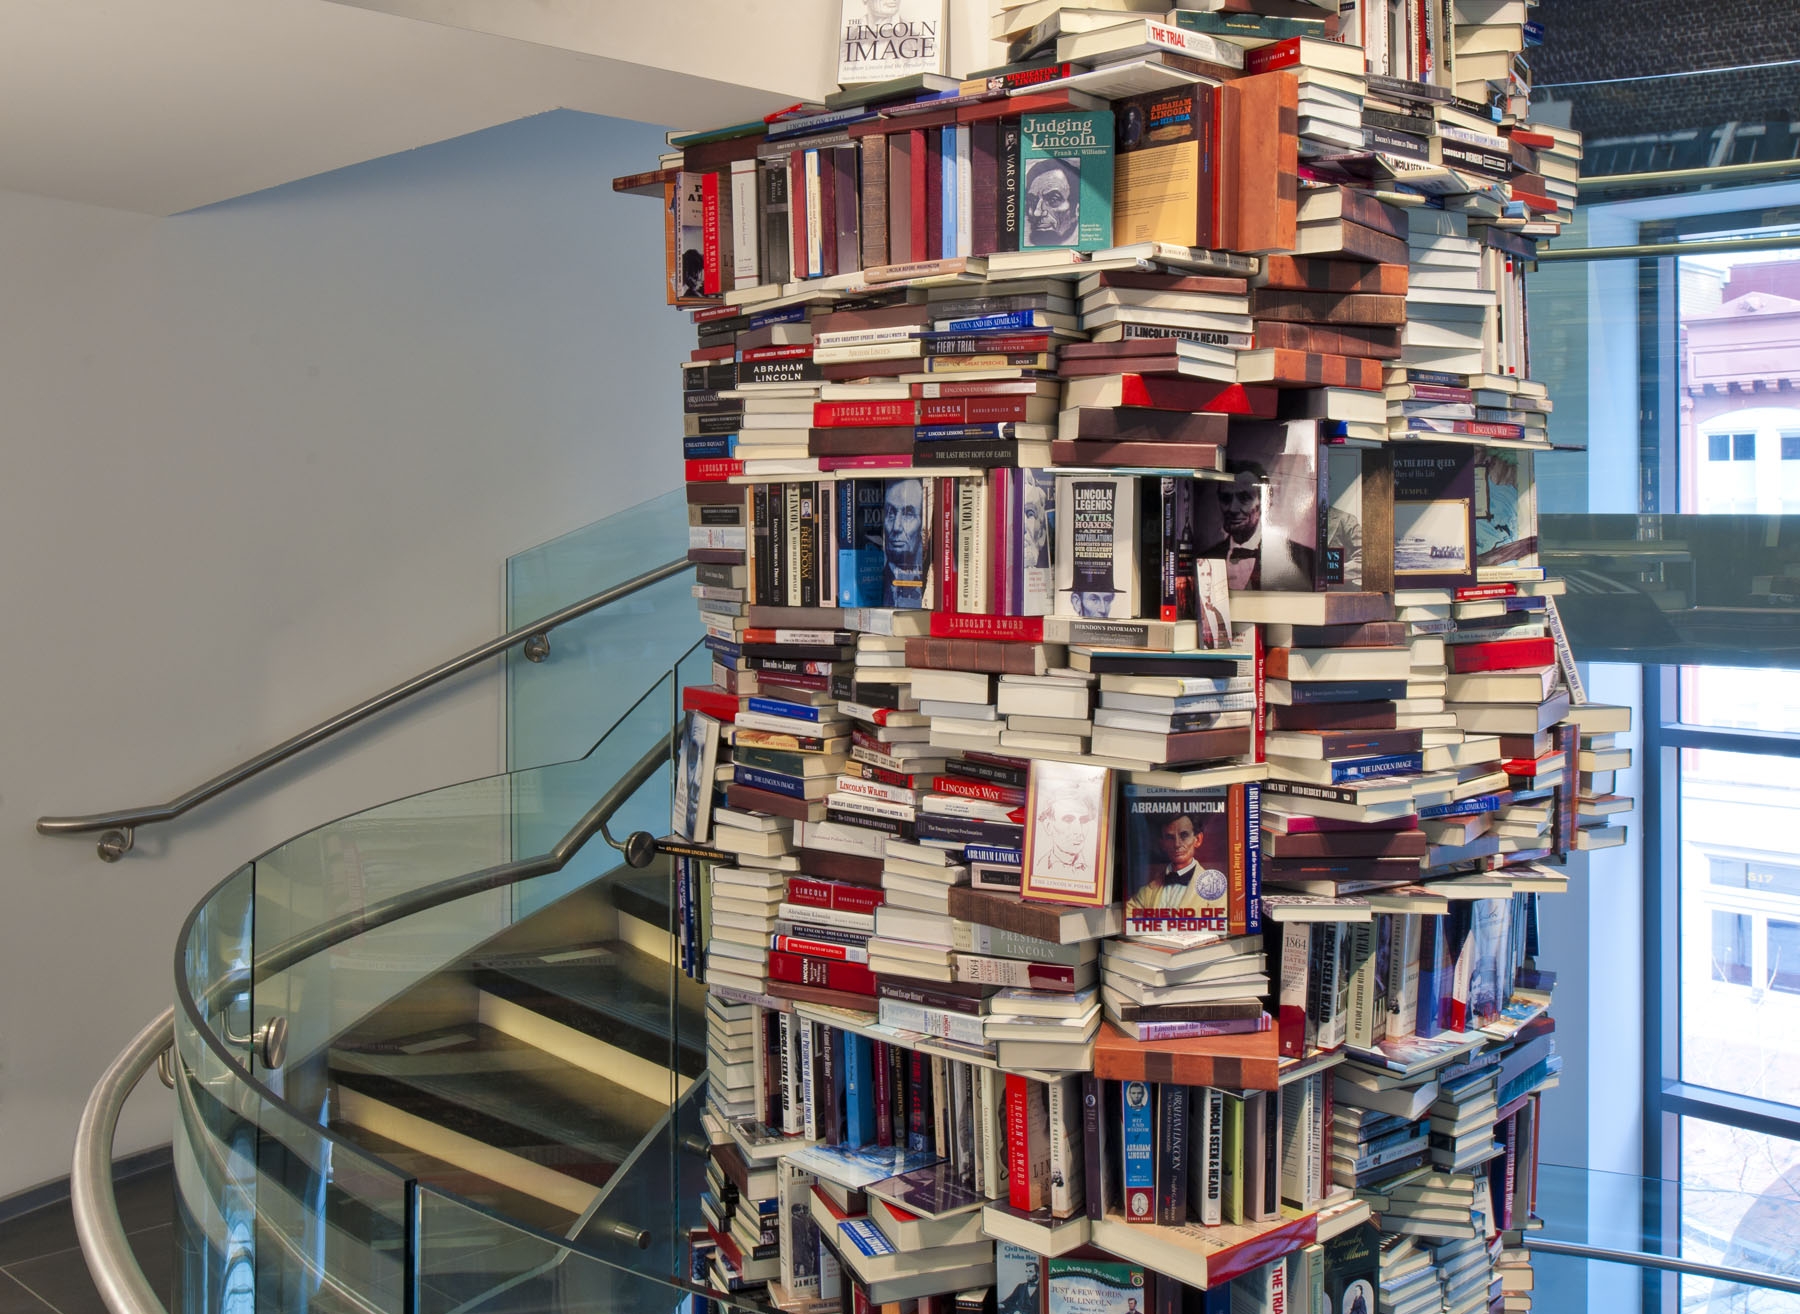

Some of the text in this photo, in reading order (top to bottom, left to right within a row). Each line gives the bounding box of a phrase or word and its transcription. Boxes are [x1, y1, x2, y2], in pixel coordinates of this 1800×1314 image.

[846, 20, 937, 42] LINCOLN
[1152, 26, 1186, 48] THE TRIAL
[844, 37, 936, 64] IMAGE
[1006, 66, 1058, 82] VINDICATING
[1015, 75, 1050, 86] LINCOLN
[1150, 98, 1192, 112] ABRAHAM
[1150, 106, 1192, 120] LINCOLN
[1024, 118, 1092, 136] Judging
[1032, 133, 1096, 148] Lincoln
[1391, 158, 1410, 171] LINCOLN
[1006, 154, 1015, 232] WAR OF WORDS
[707, 194, 716, 244] LINCOLN'S
[950, 315, 1020, 331] LINCOLN AND HIS ADMIRALS
[1134, 326, 1229, 346] LINCOLN SEEN & HEARD
[754, 364, 804, 373] ABRAHAM
[755, 373, 802, 382] LINCOLN
[832, 406, 902, 418] LINCOLN'S SWORD
[928, 405, 962, 414] LINCOLN
[1472, 423, 1508, 436] LINCOLN'S WAY
[1394, 458, 1456, 470] ON THE RIVER QUEEN
[1075, 488, 1112, 500] LINCOLN
[788, 493, 798, 532] LINCOLN
[962, 490, 973, 531] LINCOLN
[1075, 500, 1112, 511] LEGENDS
[1075, 514, 1113, 522] MYTHS,
[1075, 522, 1113, 530] HOAXES,
[1075, 534, 1112, 542] CONFABULATIONS
[950, 618, 1024, 630] LINCOLN'S SWORD
[1074, 624, 1144, 634] HERNDON'S INFORMANTS
[1360, 760, 1412, 774] THE LINCOLN IMAGE
[754, 776, 796, 790] THE LINCOLN IMAGE
[840, 780, 888, 798] LINCOLN'S WRATH
[940, 780, 1000, 800] LINCOLN'S WAY
[1131, 802, 1225, 814] ABRAHAM LINCOLN
[1250, 787, 1259, 850] ABRAHAM LINCOLN
[966, 850, 1020, 864] ABRAHAM LINCOLN
[795, 886, 828, 898] LINCOLN
[788, 909, 830, 920] Abraham Lincoln
[1132, 908, 1226, 918] FRIEND OF
[1132, 920, 1226, 932] THE PEOPLE
[1286, 936, 1307, 950] 1864
[1007, 944, 1054, 958] LINCOLN
[780, 1022, 788, 1056] LINCOLN
[782, 1083, 790, 1111] HEARD
[1210, 1098, 1220, 1135] LINCOLN
[1014, 1092, 1025, 1186] LINCOLN'S SWORD
[1126, 1144, 1151, 1152] ABRAHAM
[1210, 1136, 1220, 1160] SEEN
[1127, 1152, 1150, 1160] LINCOLN
[1208, 1170, 1218, 1200] HEARD
[794, 1278, 819, 1288] JAMES
[1134, 1276, 1141, 1285] 3
[1272, 1266, 1283, 1289] THE
[1051, 1286, 1122, 1299] JUST A FEW WORDS,
